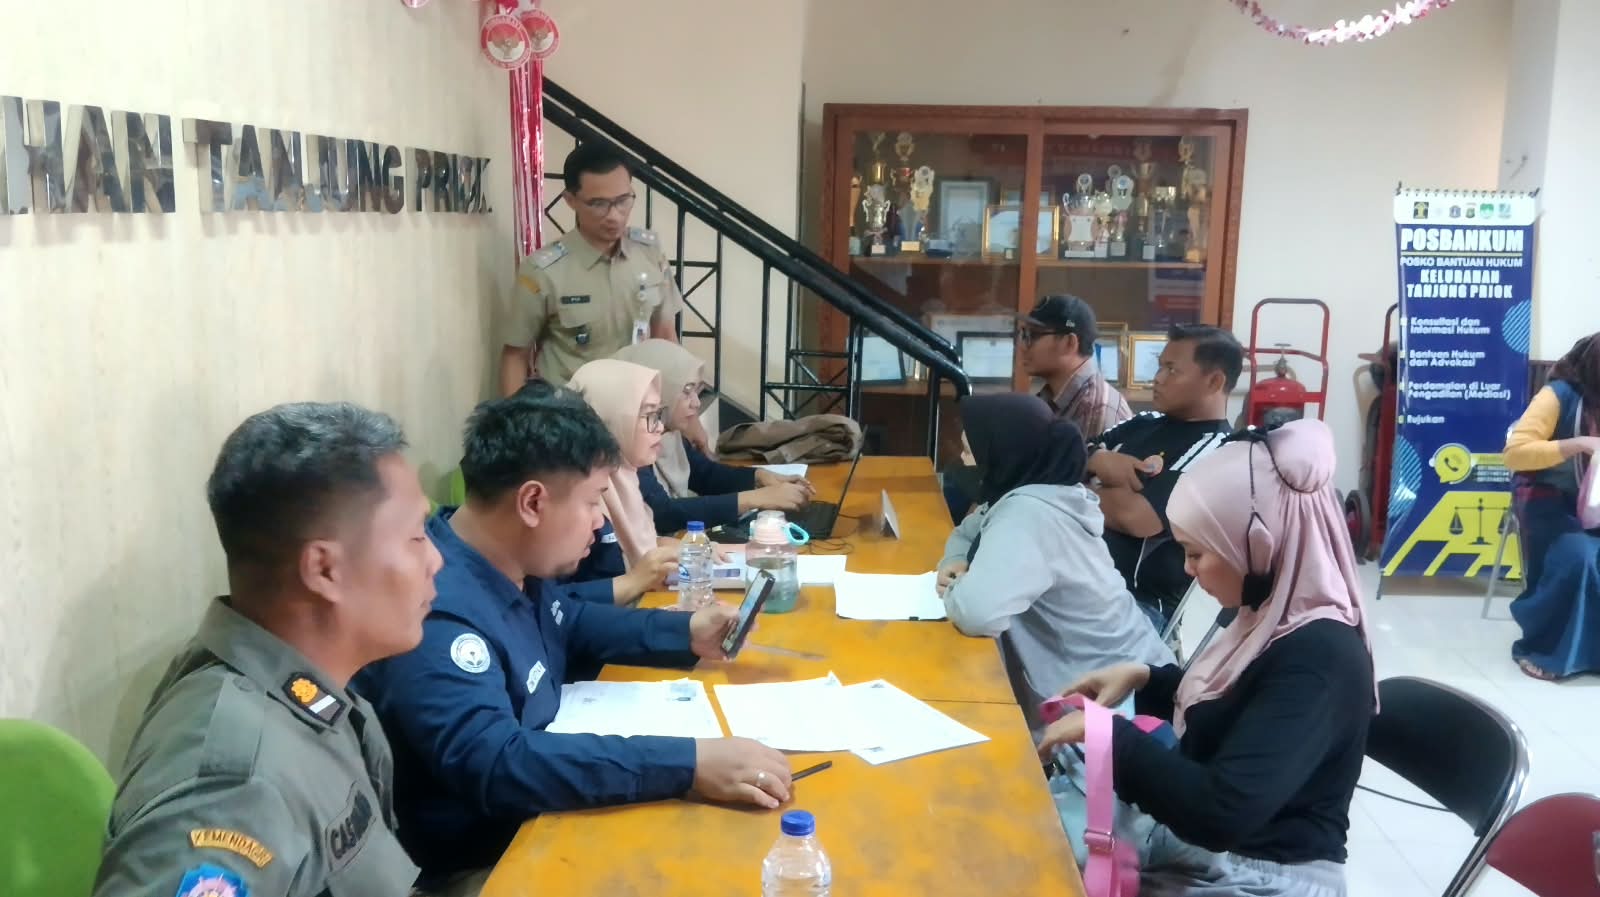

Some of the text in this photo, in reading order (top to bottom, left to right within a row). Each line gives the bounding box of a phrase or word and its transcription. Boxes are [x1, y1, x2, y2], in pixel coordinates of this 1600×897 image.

[183, 118, 405, 214] TANJUNG
[1400, 228, 1524, 252] POSBANKUM
[1400, 257, 1523, 268] POSKO BANTUAN HUKUM
[1420, 269, 1500, 284] KELURAHAN
[1406, 283, 1513, 299] TANJUNG PRIOK
[1410, 317, 1481, 326] Konsultasi dan
[1410, 325, 1491, 335] Informasi Hukum
[1409, 350, 1486, 359] Bantuan Hukum
[1409, 358, 1476, 367] dan Advokasi
[1408, 381, 1501, 391] Perdamaian di Luar
[1408, 389, 1511, 400] Pengadilan (Mediasi)
[1407, 414, 1445, 425] Rujukan
